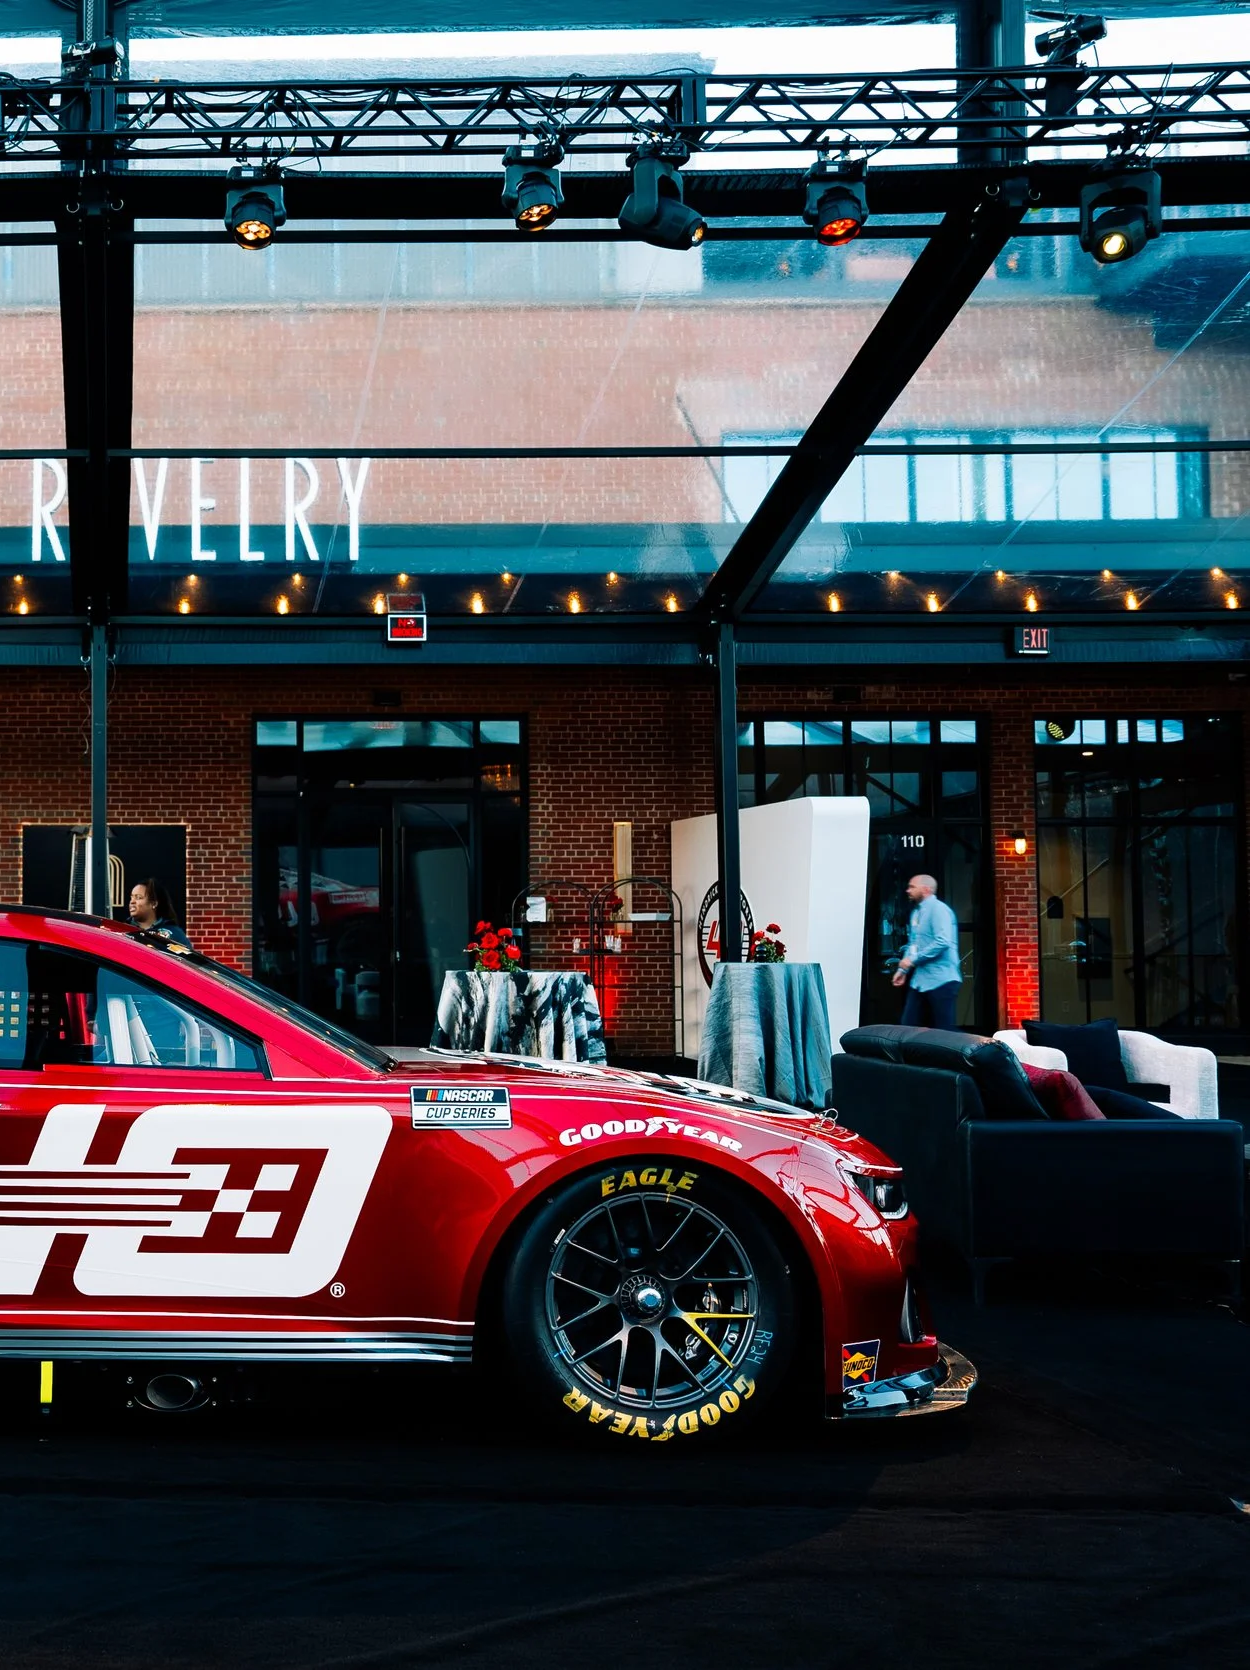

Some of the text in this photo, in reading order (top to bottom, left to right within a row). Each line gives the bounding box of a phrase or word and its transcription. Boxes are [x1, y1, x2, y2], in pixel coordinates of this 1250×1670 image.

[31, 457, 371, 563] RVELRY
[397, 617, 417, 628] NO
[1022, 628, 1049, 649] EXIT
[900, 835, 925, 848] 110
[442, 1089, 494, 1102] NASCAR
[425, 1107, 497, 1119] CUP SERIES
[558, 1115, 743, 1154] GOODYEAR
[600, 1167, 699, 1198] EAGLE
[562, 1374, 757, 1442] GOODYEAR
